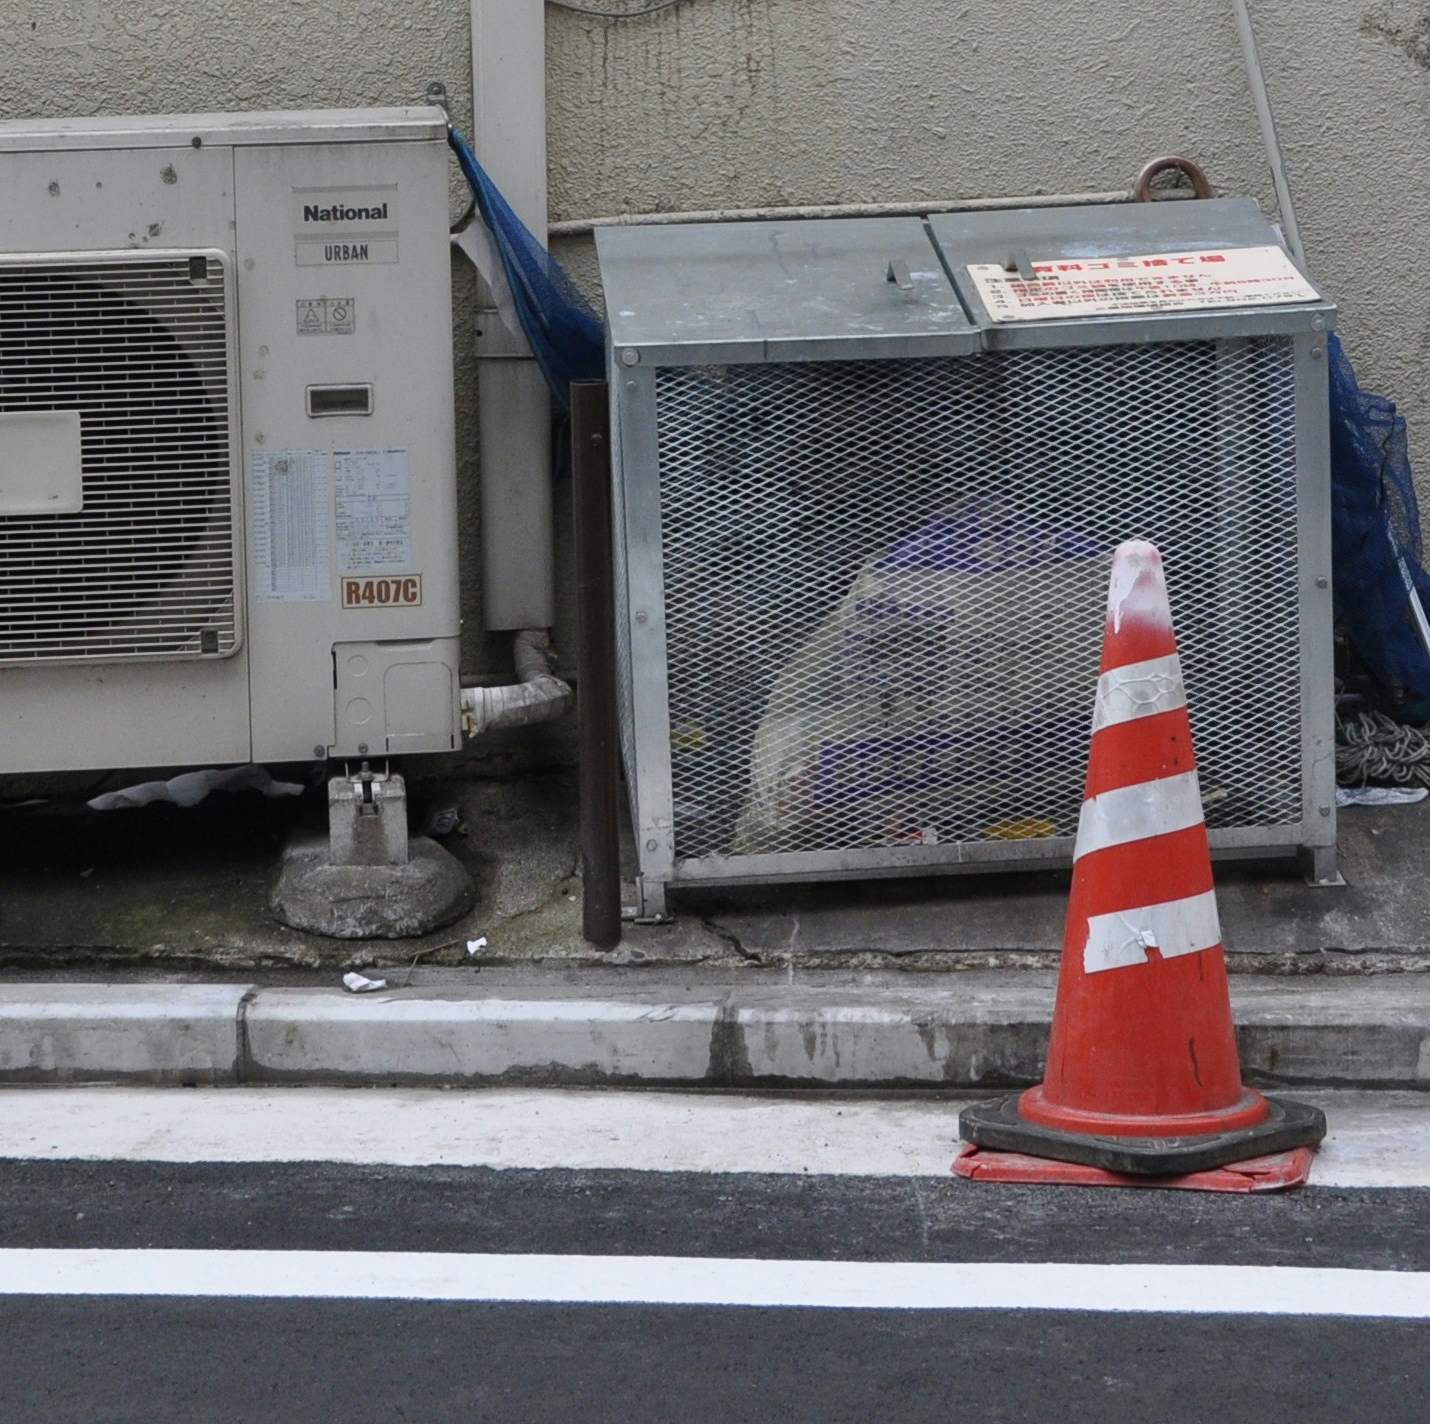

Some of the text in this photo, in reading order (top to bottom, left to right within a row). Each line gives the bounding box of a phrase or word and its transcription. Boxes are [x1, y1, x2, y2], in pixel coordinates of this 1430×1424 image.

[304, 202, 388, 222] National
[325, 244, 369, 261] URBAN
[346, 578, 418, 605] R407C
